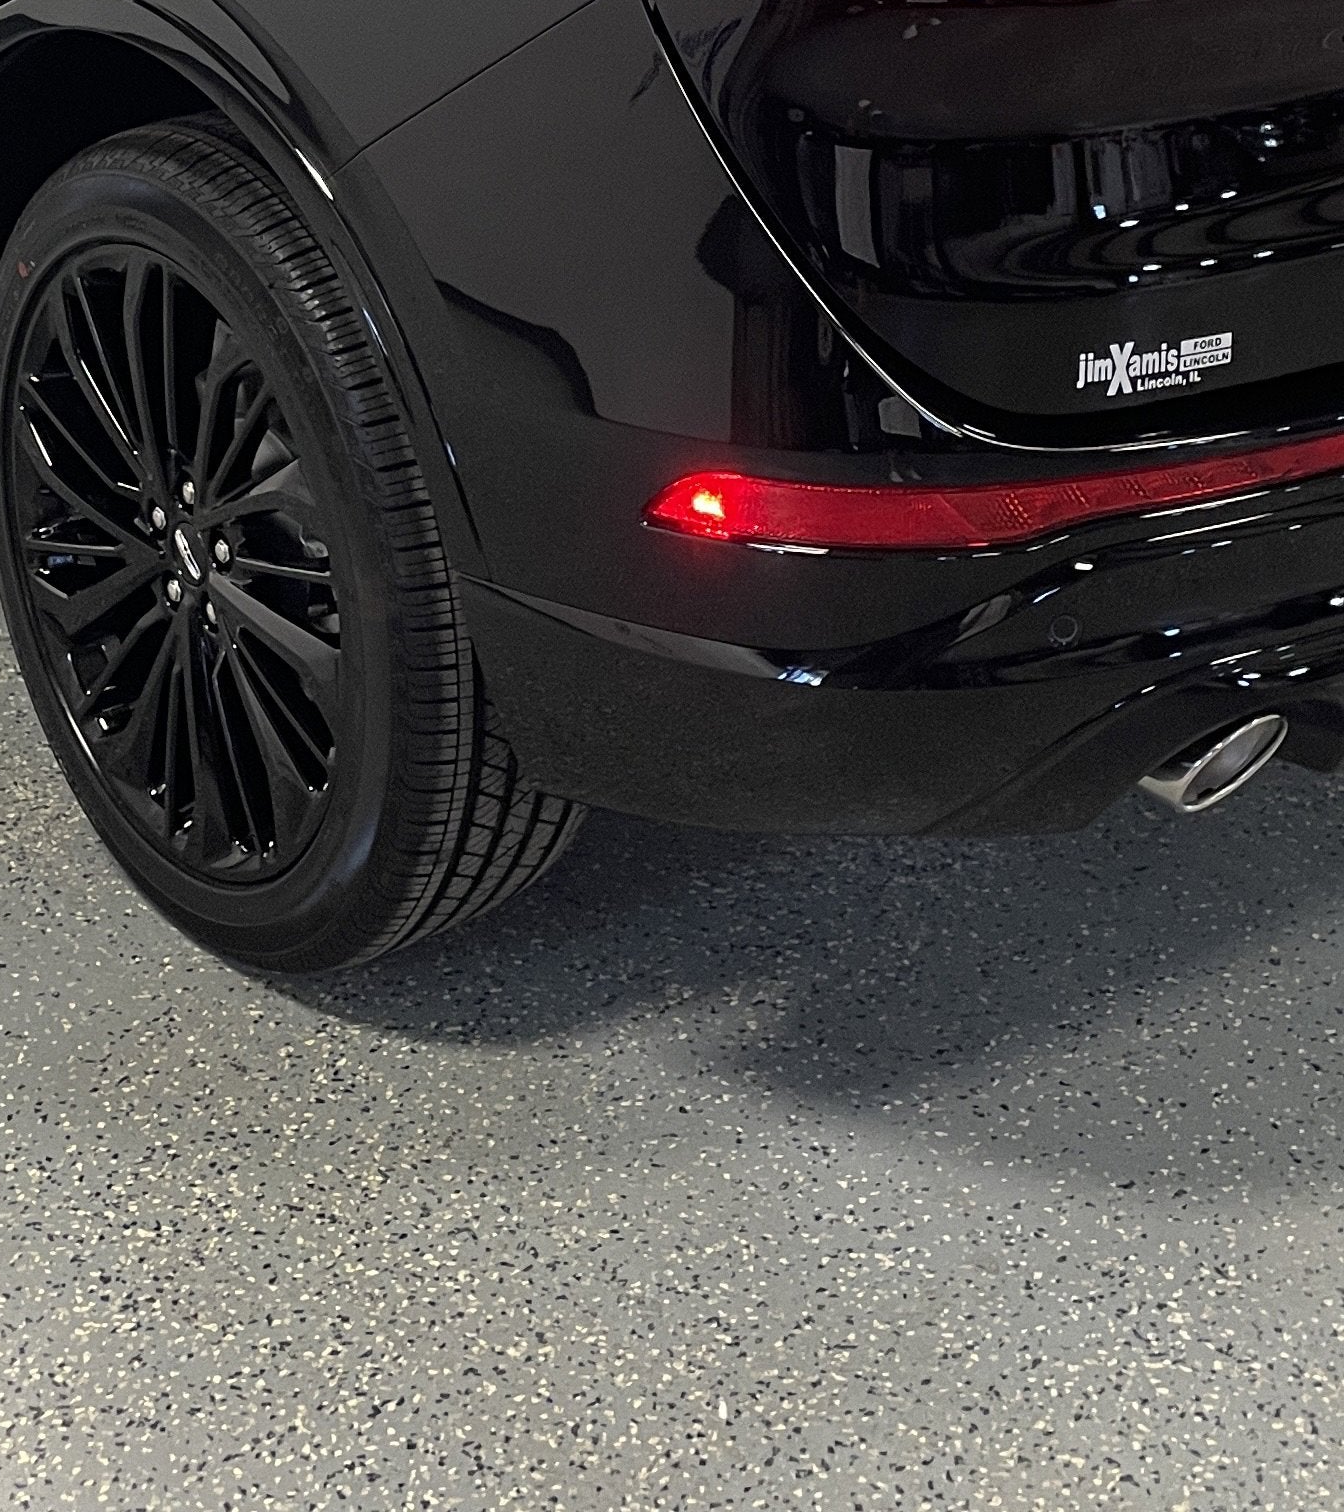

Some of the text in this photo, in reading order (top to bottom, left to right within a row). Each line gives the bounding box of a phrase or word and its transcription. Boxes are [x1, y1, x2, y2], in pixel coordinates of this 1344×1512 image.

[1193, 337, 1223, 351] FORD
[1183, 352, 1230, 368] LINCOLN
[1137, 371, 1202, 391] Lincoln, IL
